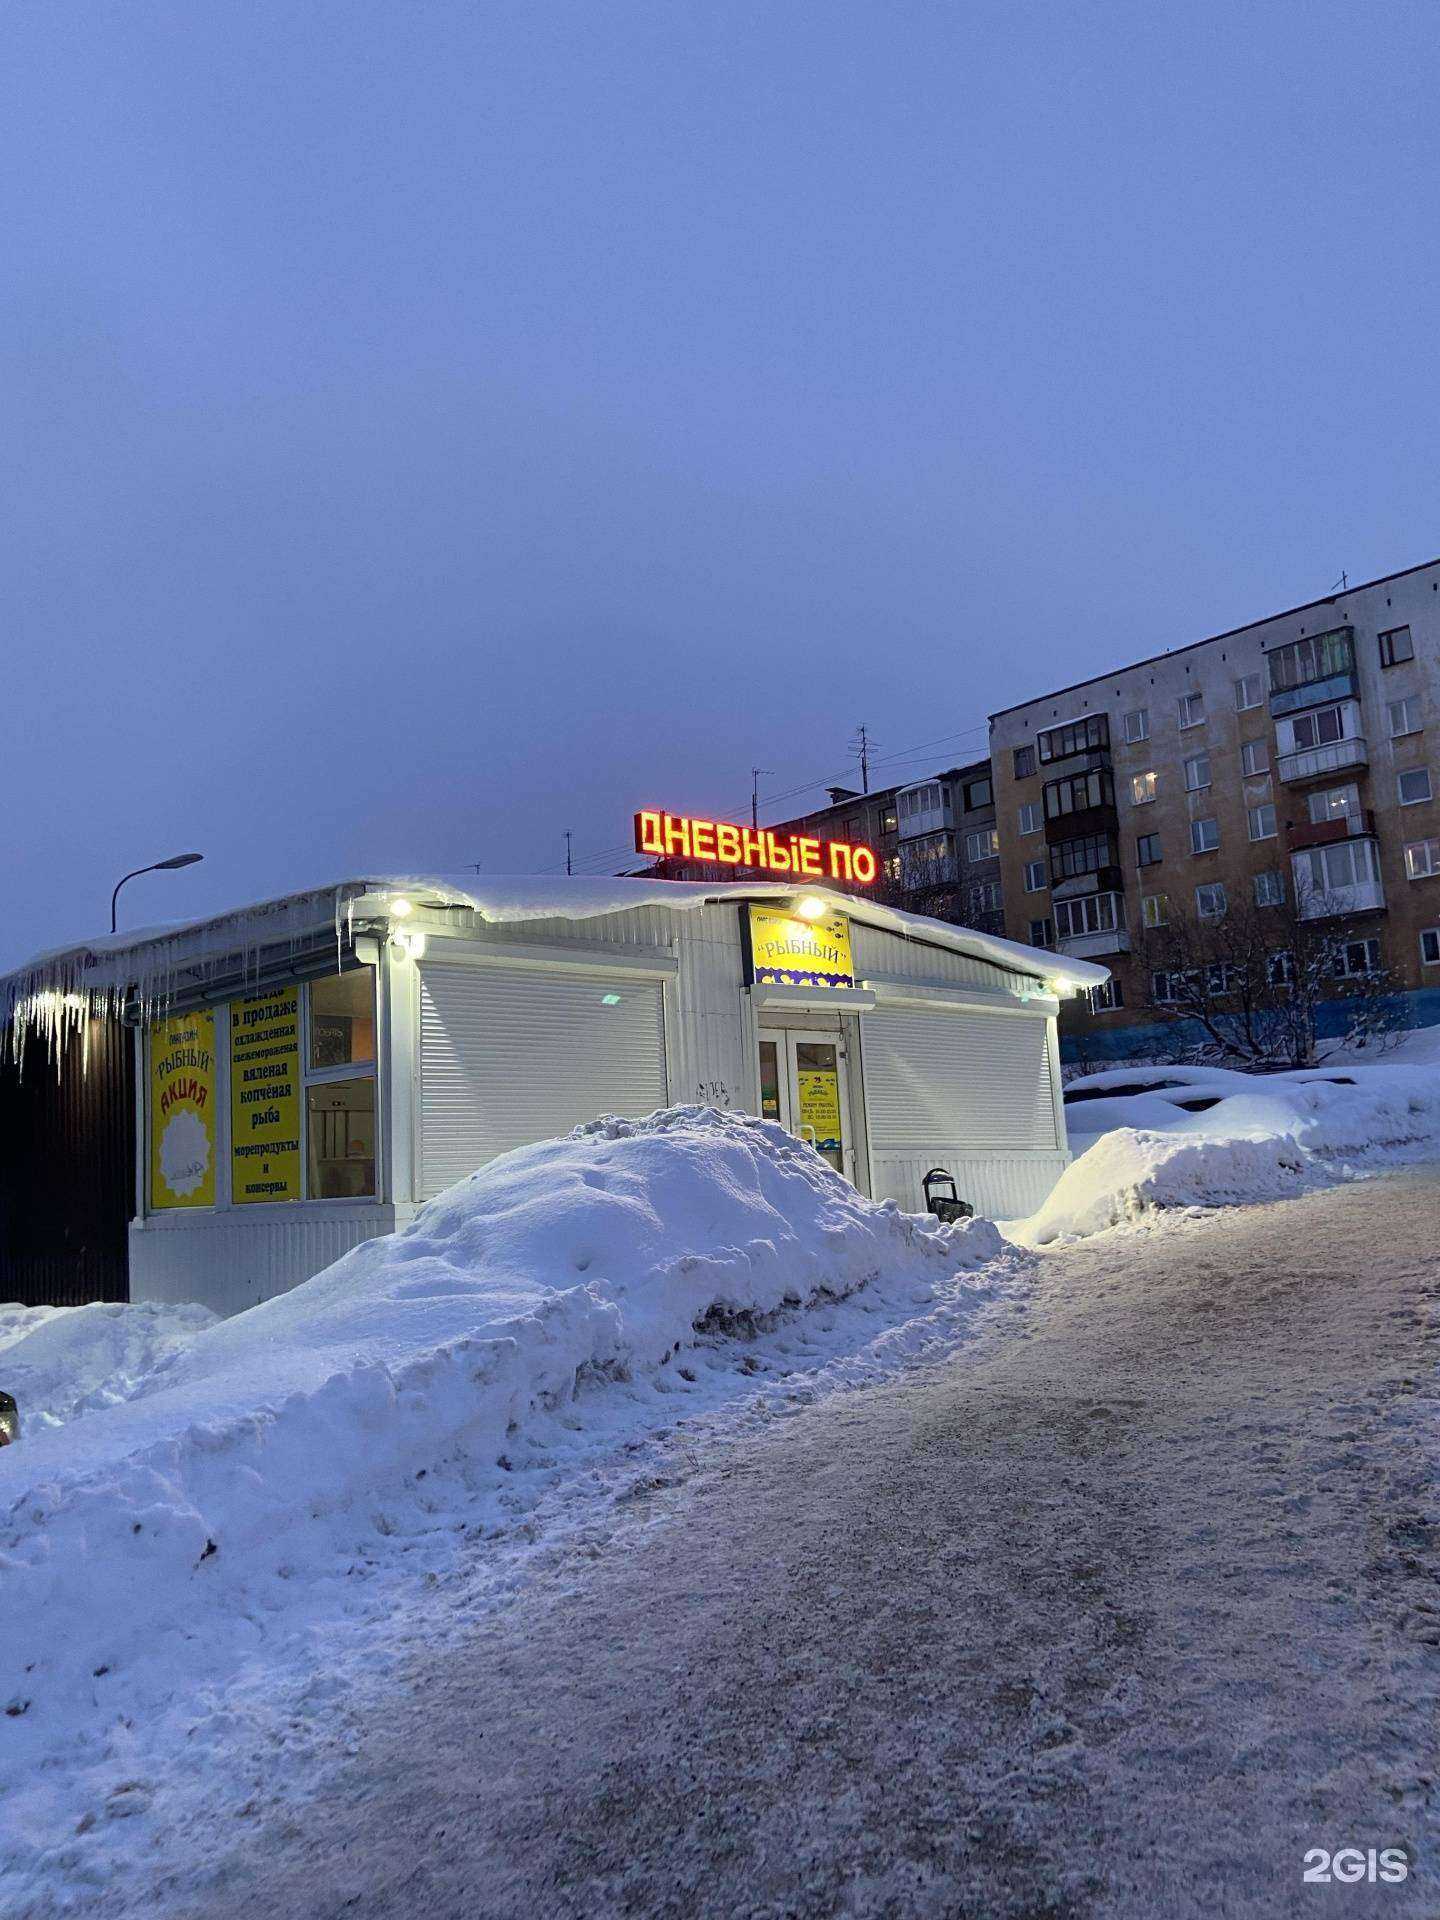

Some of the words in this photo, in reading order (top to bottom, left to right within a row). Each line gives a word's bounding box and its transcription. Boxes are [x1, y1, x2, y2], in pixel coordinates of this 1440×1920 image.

[640, 811, 823, 876] ДНЕВНЫЕ
[829, 841, 876, 882] ПО
[232, 1013, 240, 1027] в
[243, 1000, 298, 1027] продаже
[243, 1062, 288, 1081] вяленая
[160, 1077, 208, 1114] АКЦИЯ
[240, 1083, 292, 1104] копчёная
[251, 1105, 280, 1129] рыба
[234, 1139, 299, 1159] морепродукты
[263, 1163, 269, 1174] и
[245, 1181, 288, 1195] консервы
